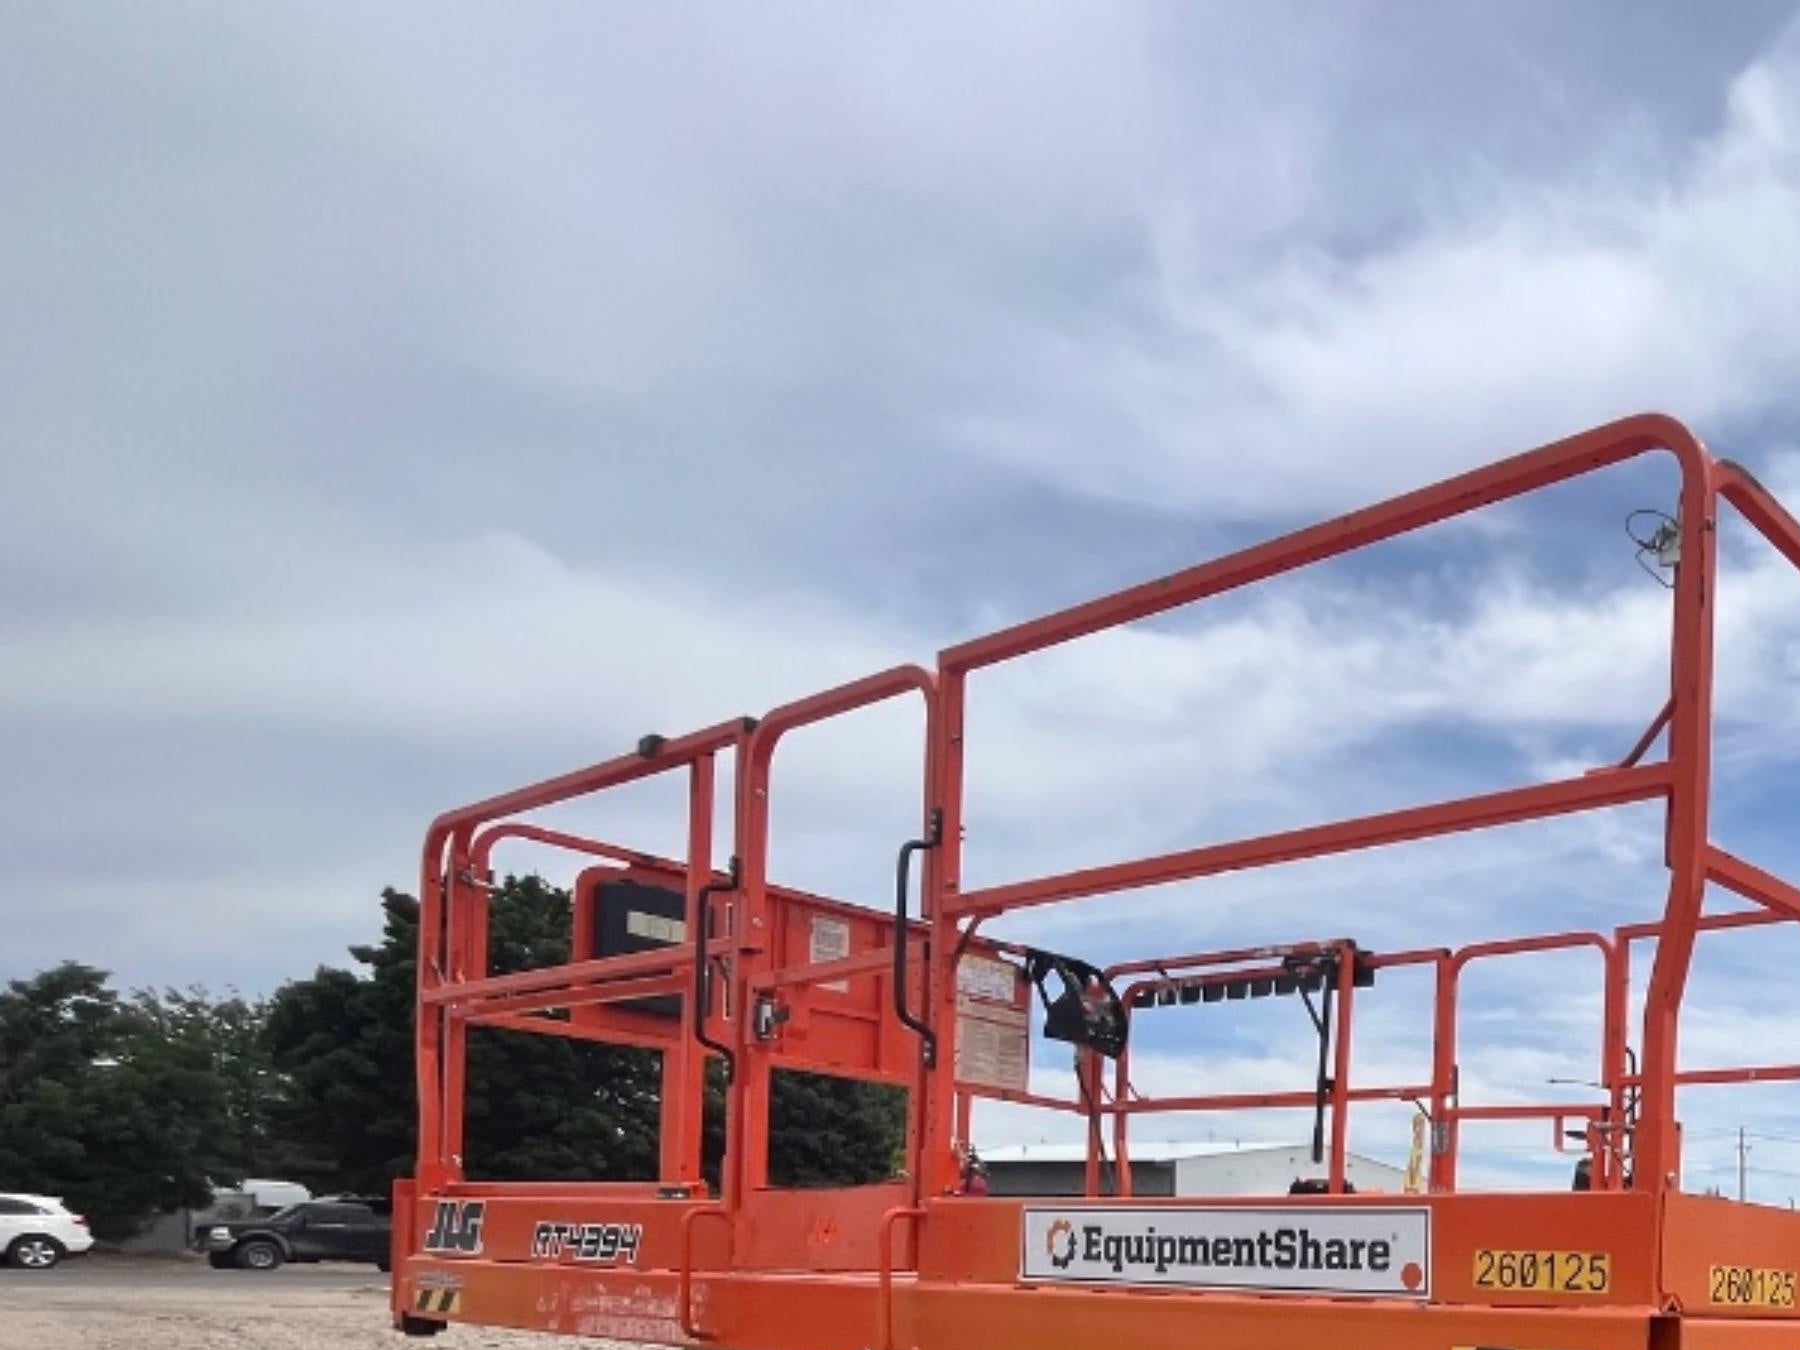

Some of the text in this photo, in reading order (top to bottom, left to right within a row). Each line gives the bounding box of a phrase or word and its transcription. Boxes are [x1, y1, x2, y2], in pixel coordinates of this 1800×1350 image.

[424, 1199, 486, 1254] JLG
[531, 1222, 643, 1263] RT4394
[1082, 1226, 1391, 1274] EquipmentShare
[1476, 1250, 1608, 1291] 260125
[1711, 1268, 1796, 1306] 260125
